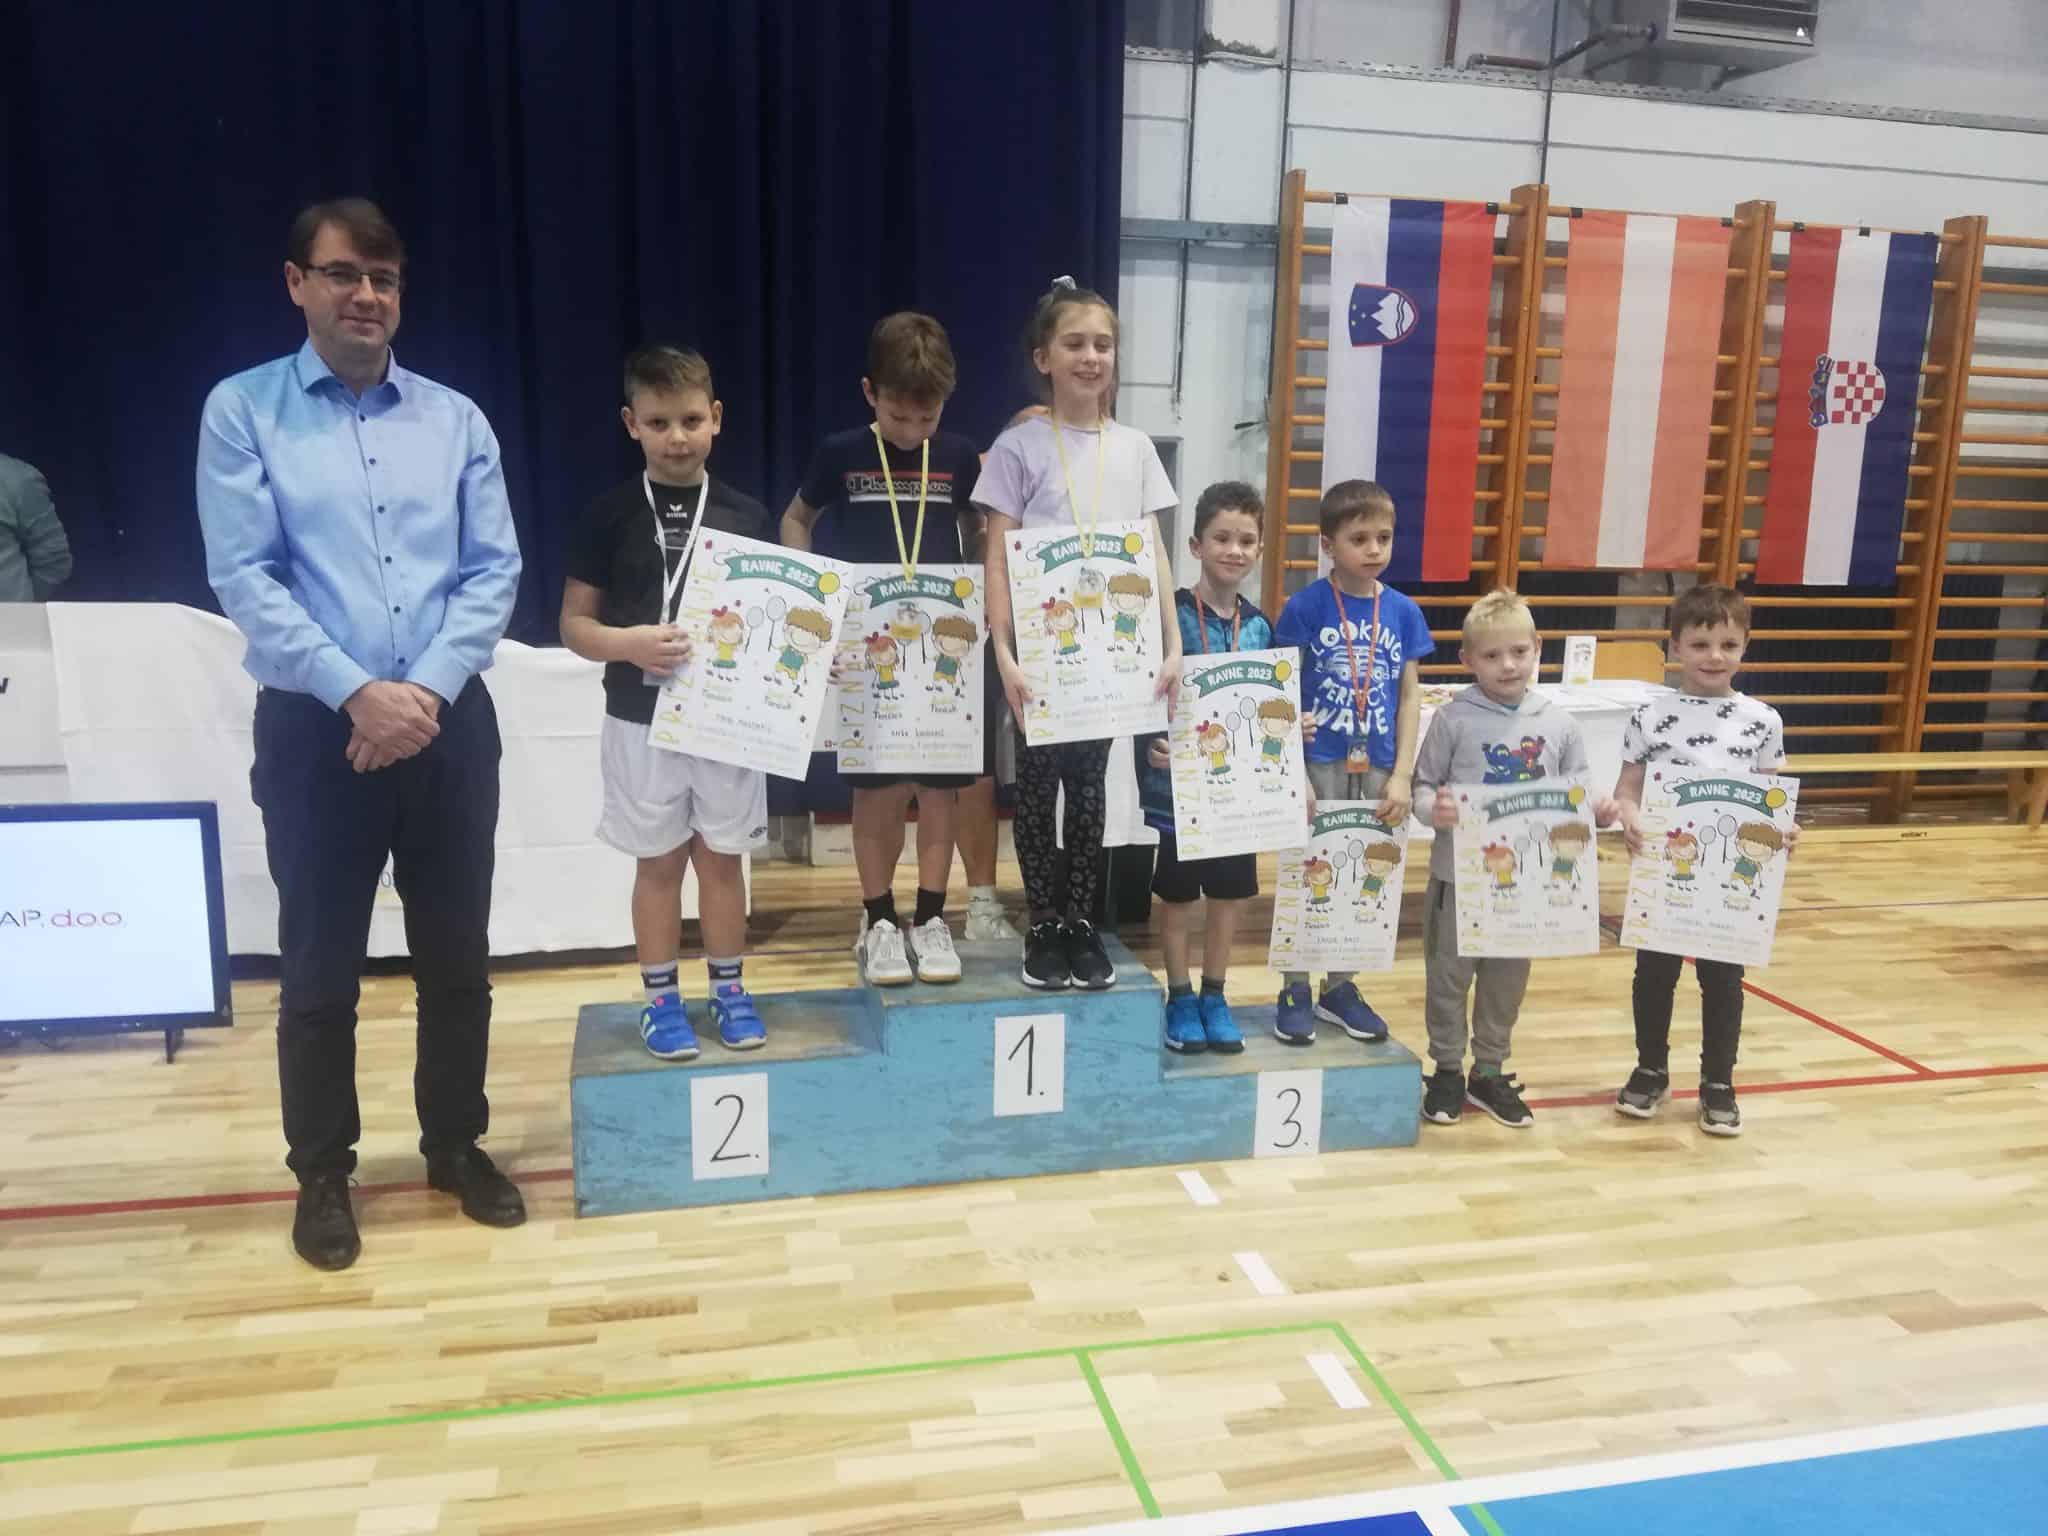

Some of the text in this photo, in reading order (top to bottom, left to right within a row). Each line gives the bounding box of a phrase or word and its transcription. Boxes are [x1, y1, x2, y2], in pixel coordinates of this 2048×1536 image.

[1095, 541, 1121, 554] 2023
[740, 560, 816, 588] RAVNE 2023
[922, 581, 951, 597] 2023
[1310, 619, 1402, 663] LOOKING
[1208, 667, 1272, 686] RAVNE 2023
[1311, 697, 1389, 736] WAVE
[1689, 785, 1762, 804] RAVNE 2023
[1323, 812, 1357, 828] RAVNE
[1008, 1024, 1045, 1096] 1.
[710, 1094, 760, 1164] 2.
[1273, 1088, 1309, 1149] 3.
